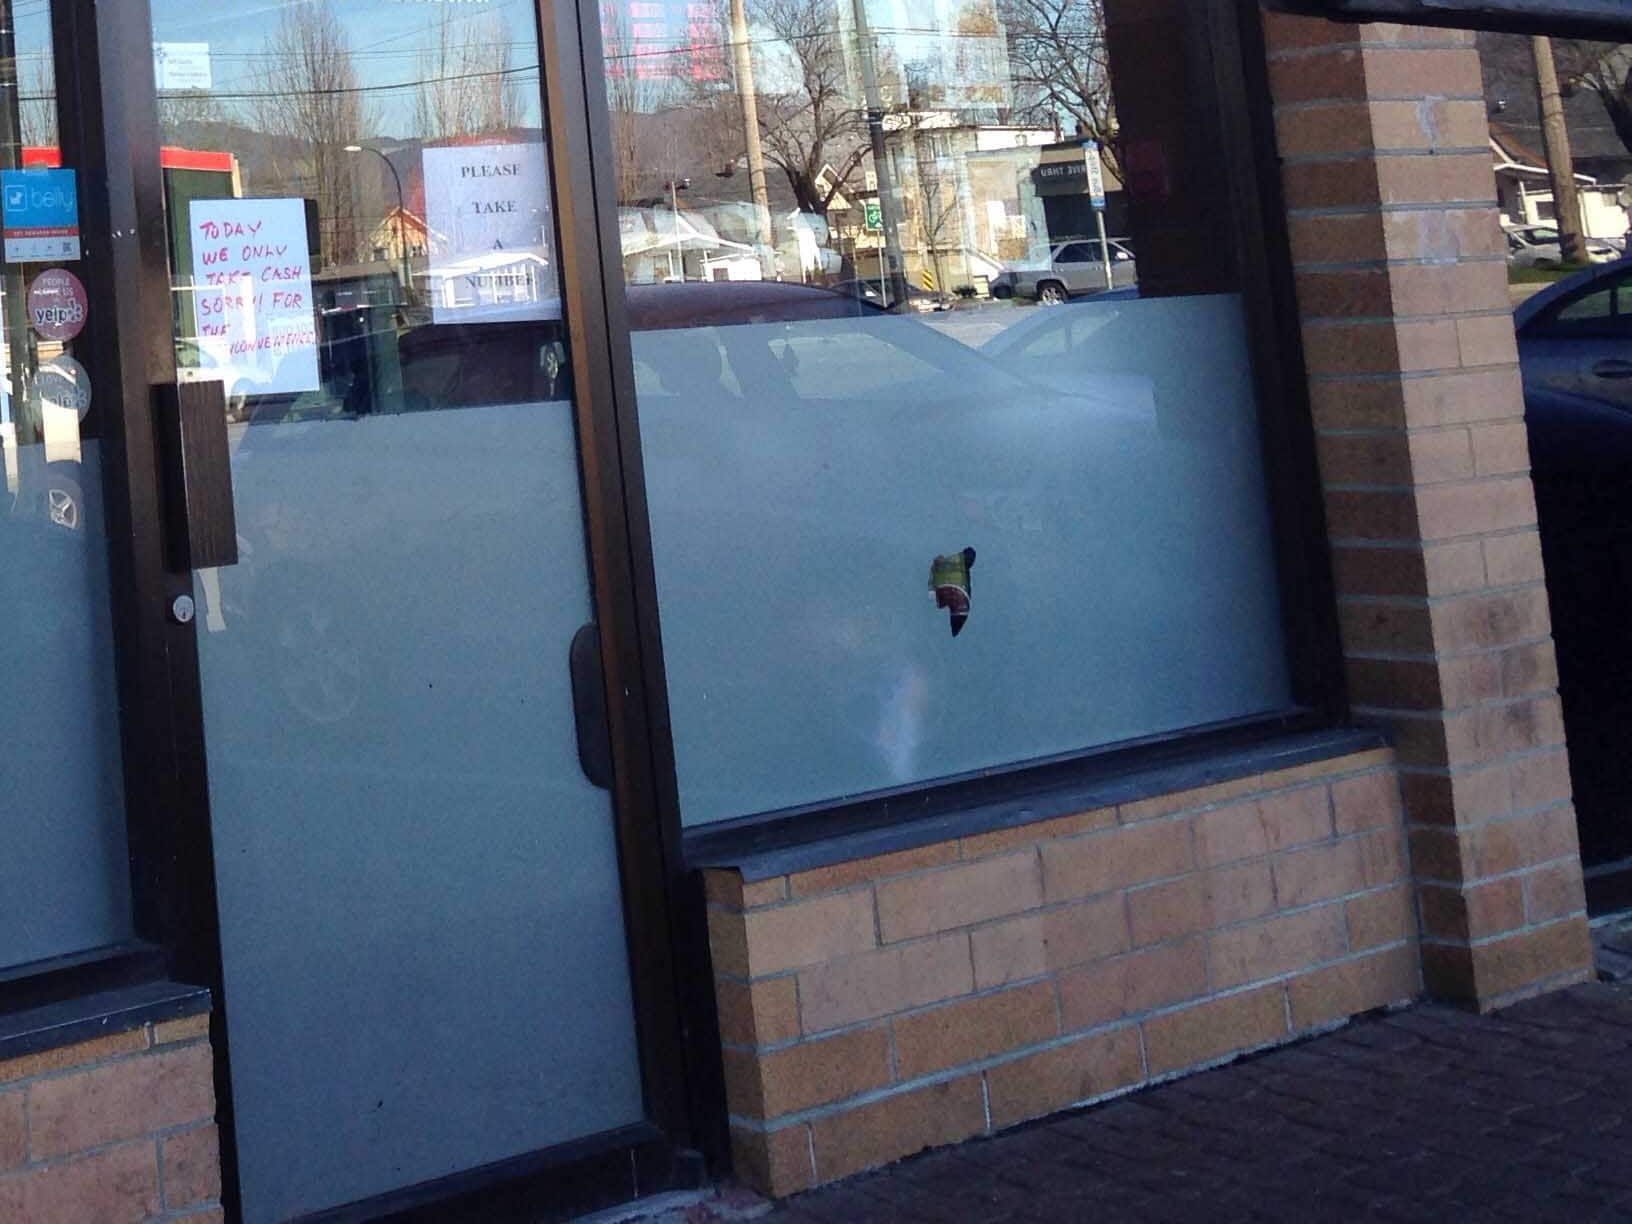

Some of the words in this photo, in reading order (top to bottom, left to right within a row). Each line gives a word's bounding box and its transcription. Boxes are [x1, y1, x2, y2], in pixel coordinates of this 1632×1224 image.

[461, 163, 521, 178] PLEASE
[31, 185, 74, 214] belly
[472, 200, 518, 214] TAKE
[200, 220, 263, 240] TODAY
[492, 238, 504, 250] A
[202, 246, 229, 266] WE
[261, 265, 302, 282] CASH
[273, 291, 303, 310] FOR
[36, 307, 68, 325] yelp
